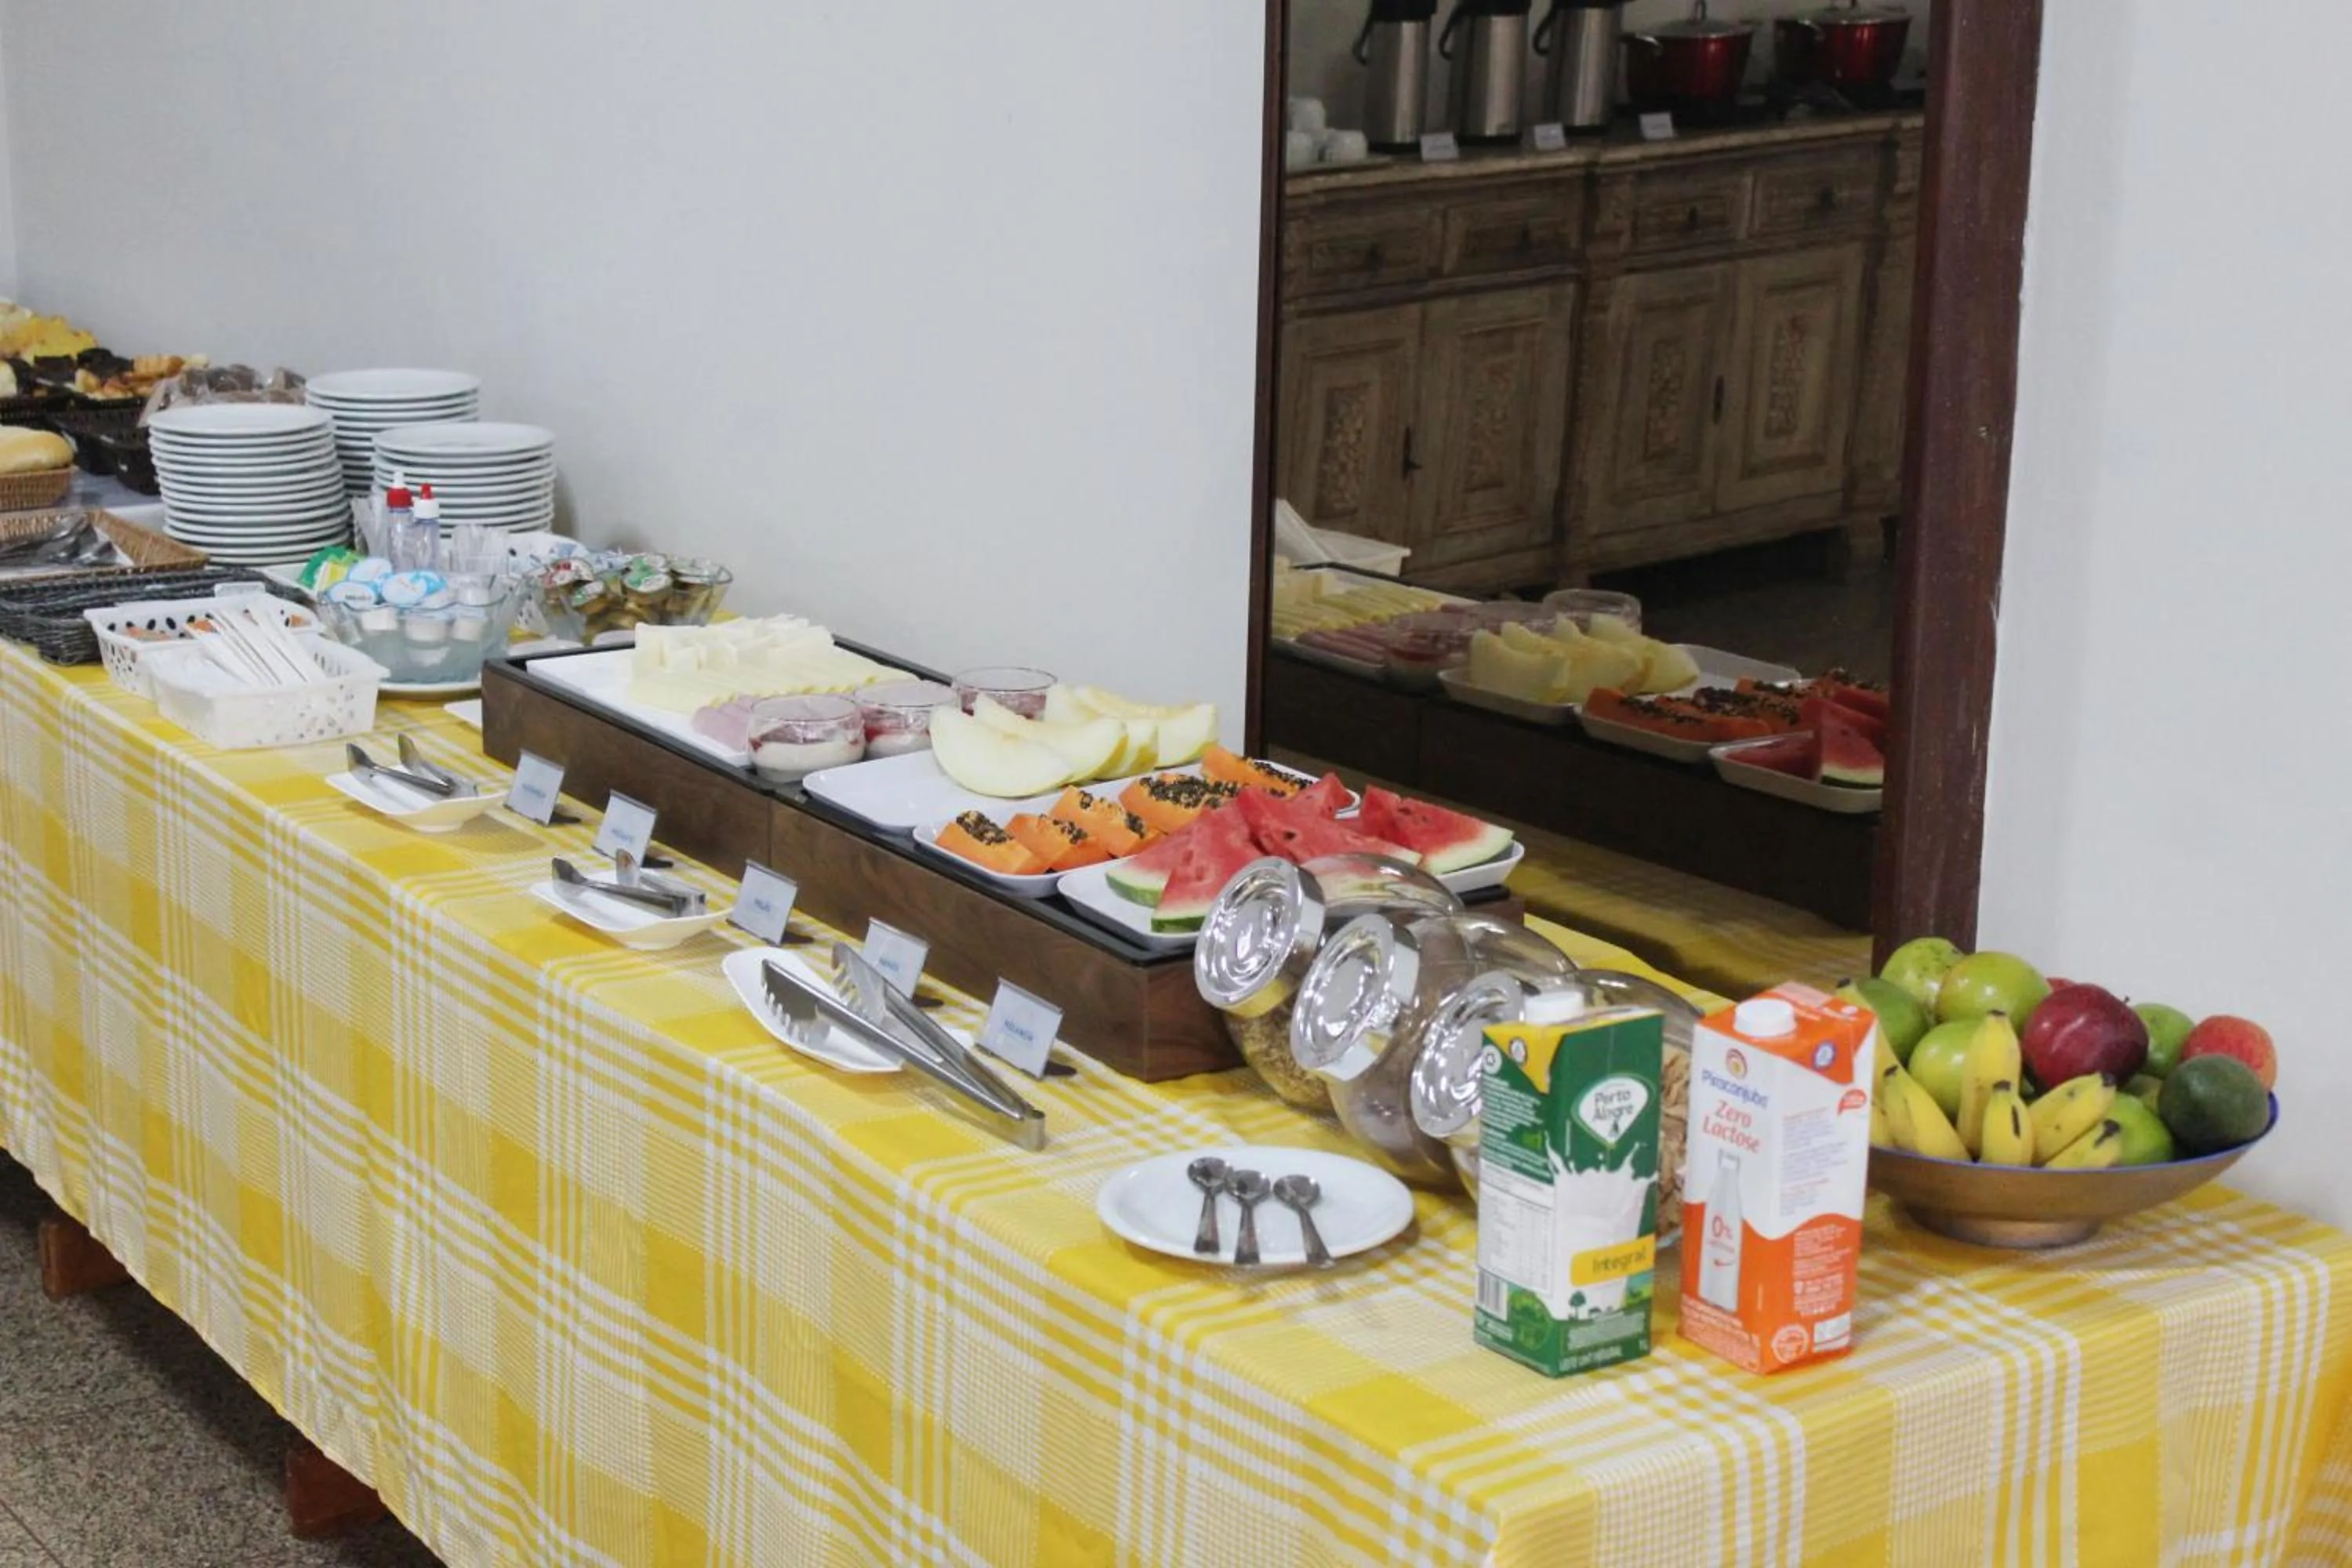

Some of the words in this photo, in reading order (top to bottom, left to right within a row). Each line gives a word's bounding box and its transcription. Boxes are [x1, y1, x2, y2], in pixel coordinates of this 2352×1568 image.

[1594, 1091, 1631, 1105] Porto
[1715, 1099, 1753, 1129] Zero
[1703, 1114, 1761, 1154] Lactose
[1592, 1245, 1646, 1273] Integral
